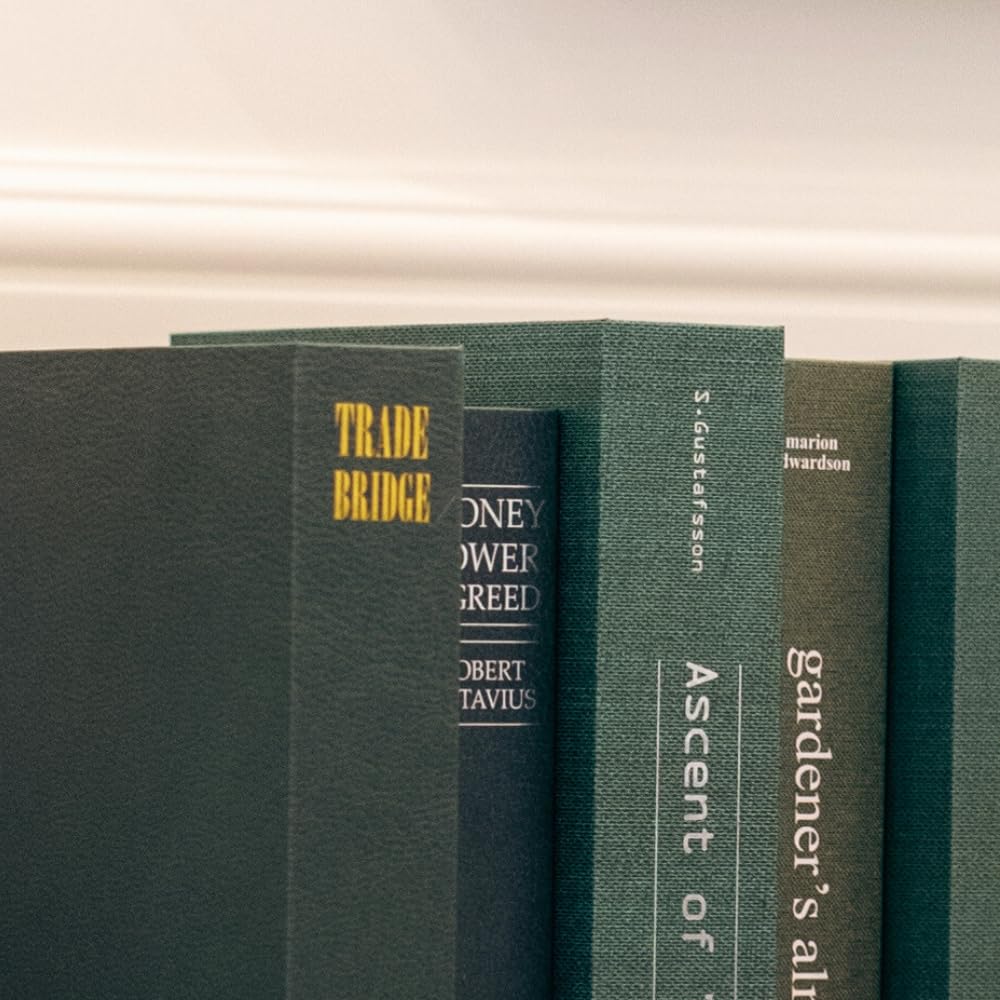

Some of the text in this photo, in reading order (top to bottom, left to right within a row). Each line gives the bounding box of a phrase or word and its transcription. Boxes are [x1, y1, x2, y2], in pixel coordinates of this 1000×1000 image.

[335, 403, 430, 460] TRADE
[785, 433, 838, 451] marion
[332, 469, 431, 524] BRIDGE
[460, 542, 539, 573] WER
[682, 660, 719, 854] Ascent
[681, 893, 715, 953] of
